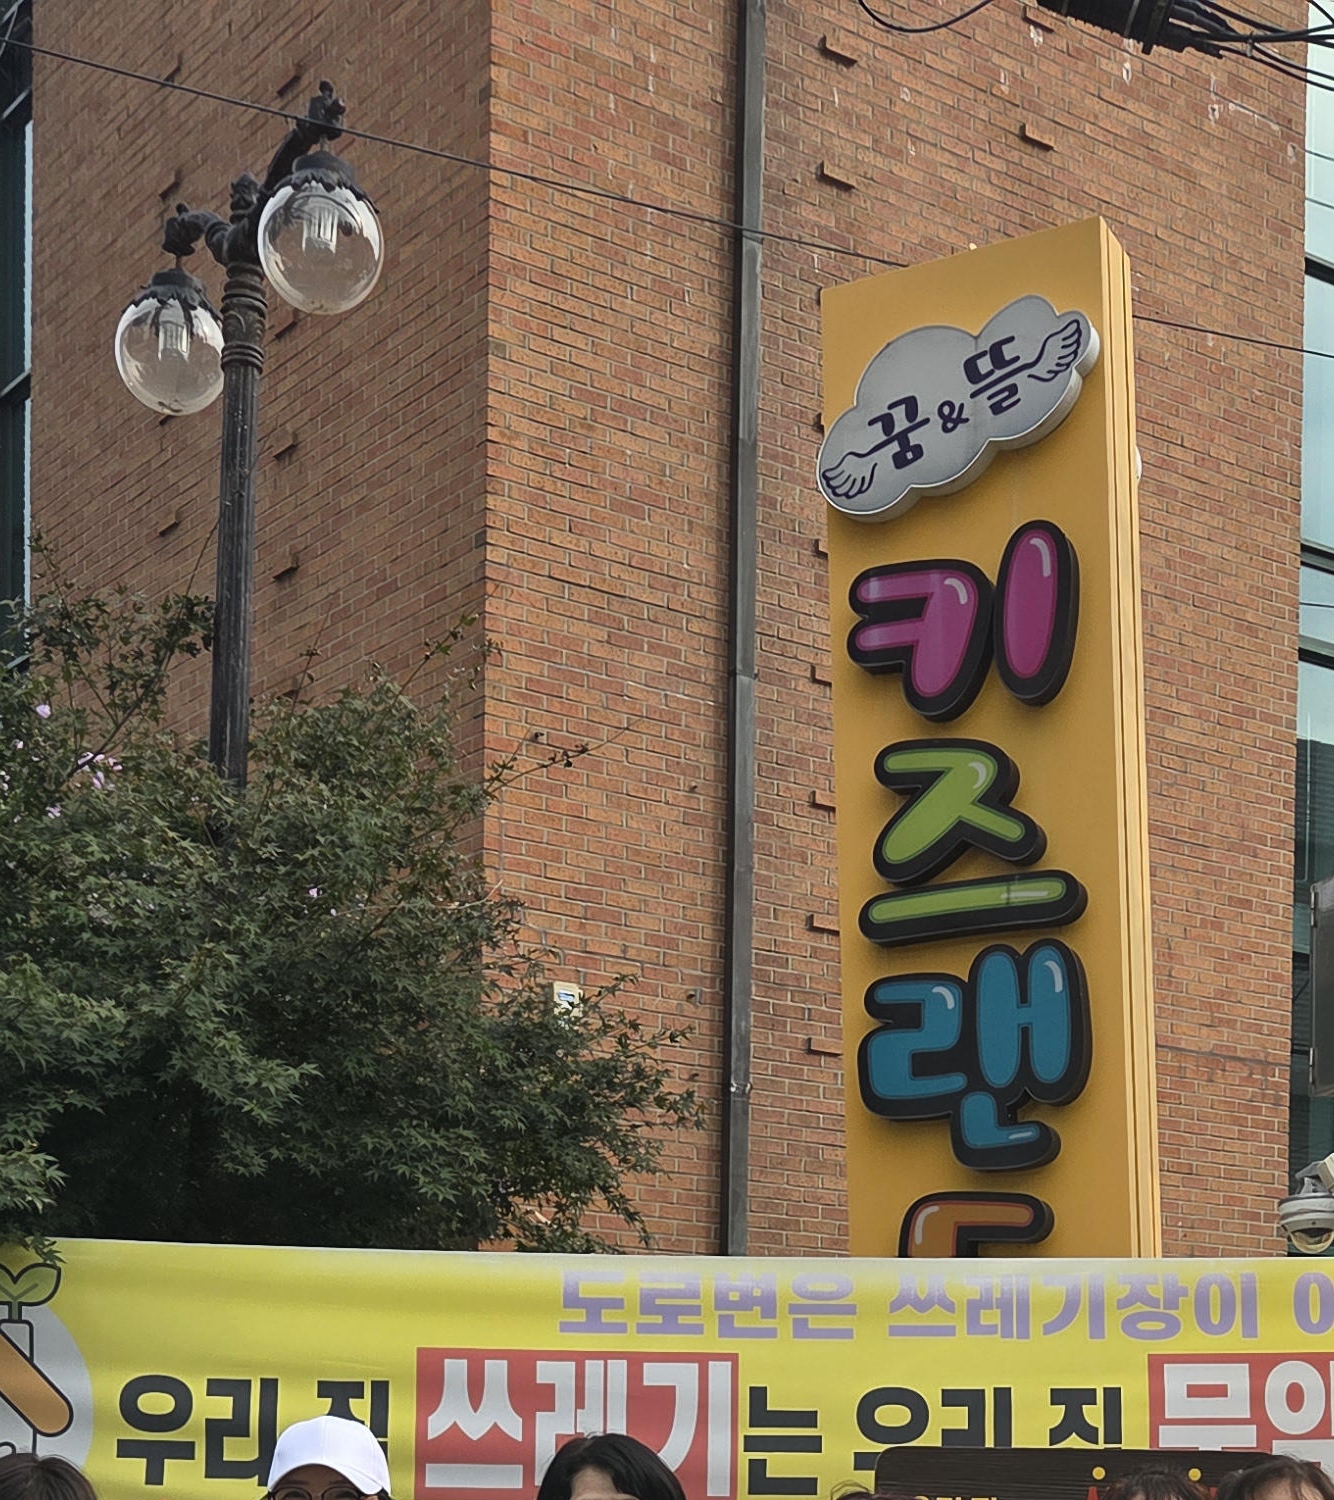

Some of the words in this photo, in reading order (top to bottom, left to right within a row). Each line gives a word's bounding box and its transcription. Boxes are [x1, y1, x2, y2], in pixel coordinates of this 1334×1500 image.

[559, 1270, 858, 1339] 도로변은
[888, 1269, 1261, 1340] 쓰레기장이
[116, 1375, 279, 1487] 우리
